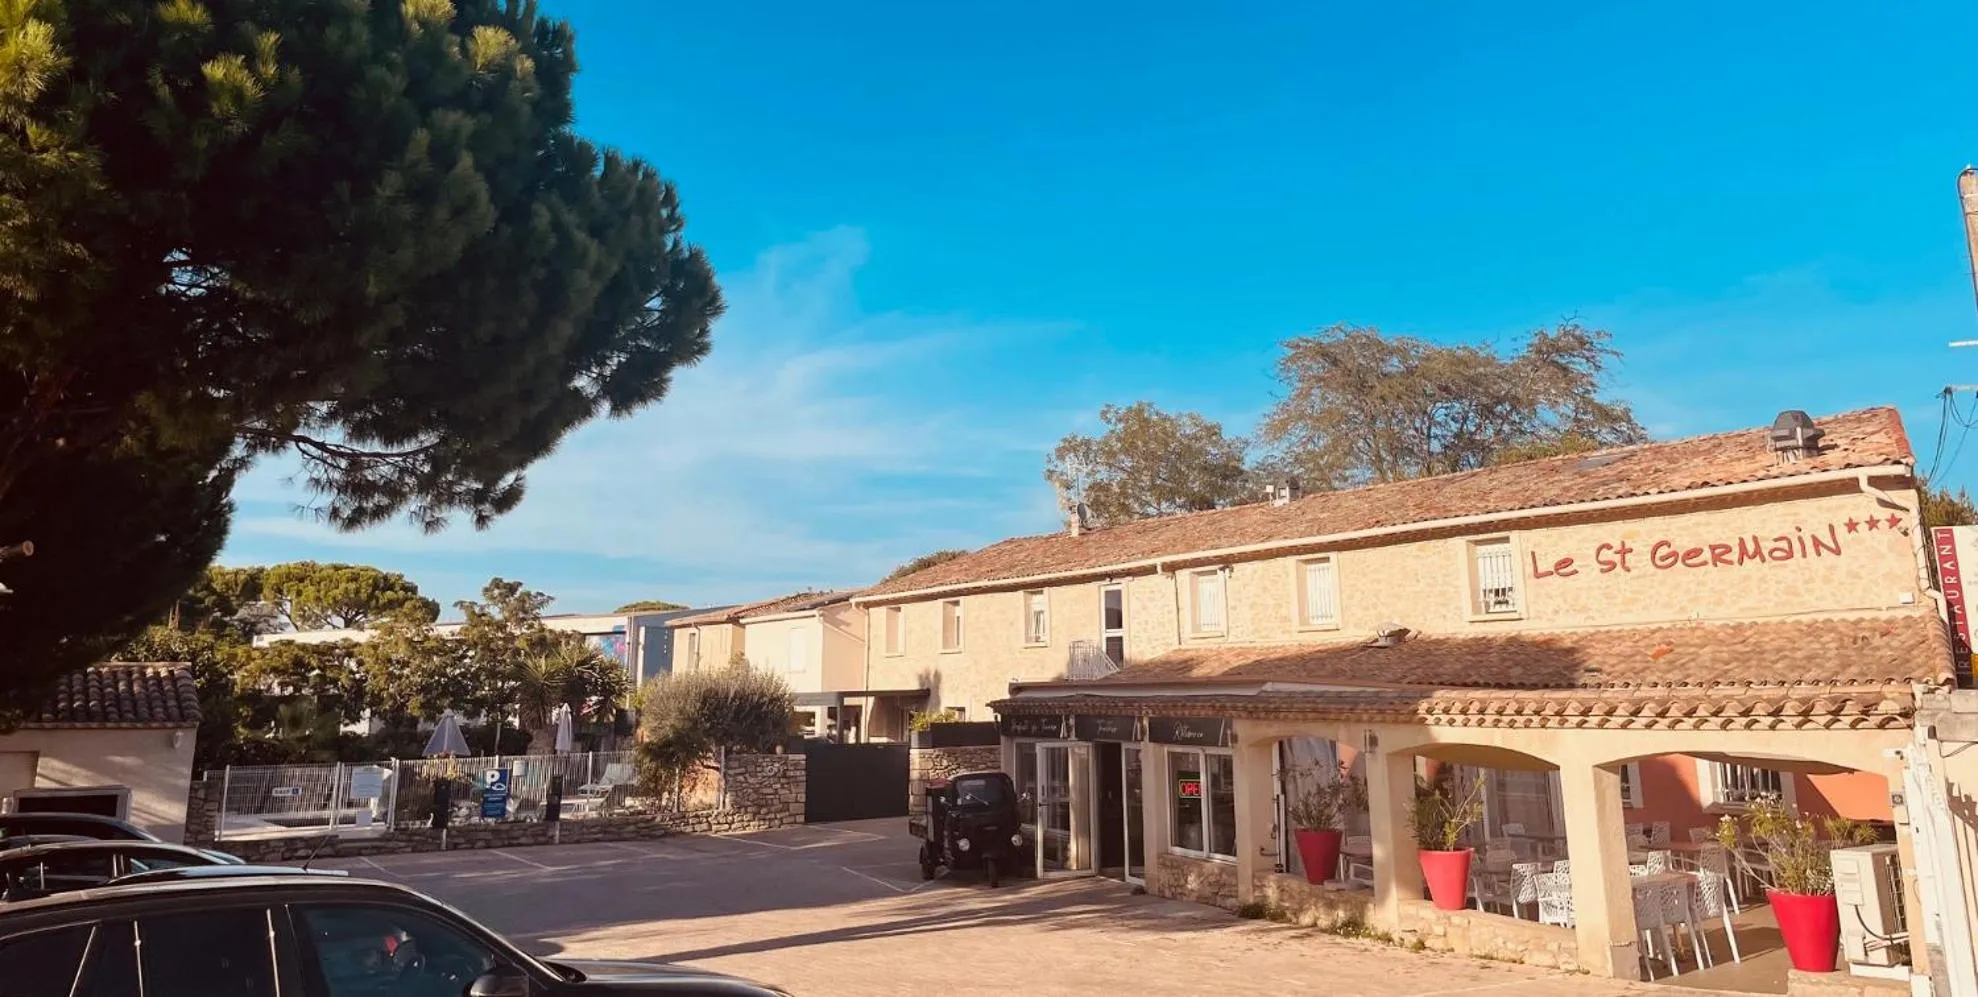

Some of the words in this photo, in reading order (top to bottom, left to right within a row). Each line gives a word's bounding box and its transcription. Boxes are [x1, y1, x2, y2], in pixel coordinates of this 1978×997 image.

[1531, 550, 1579, 579] Le
[1595, 541, 1632, 574] St
[1936, 531, 1970, 669] RESTAURANT
[1180, 782, 1201, 796] OPE
